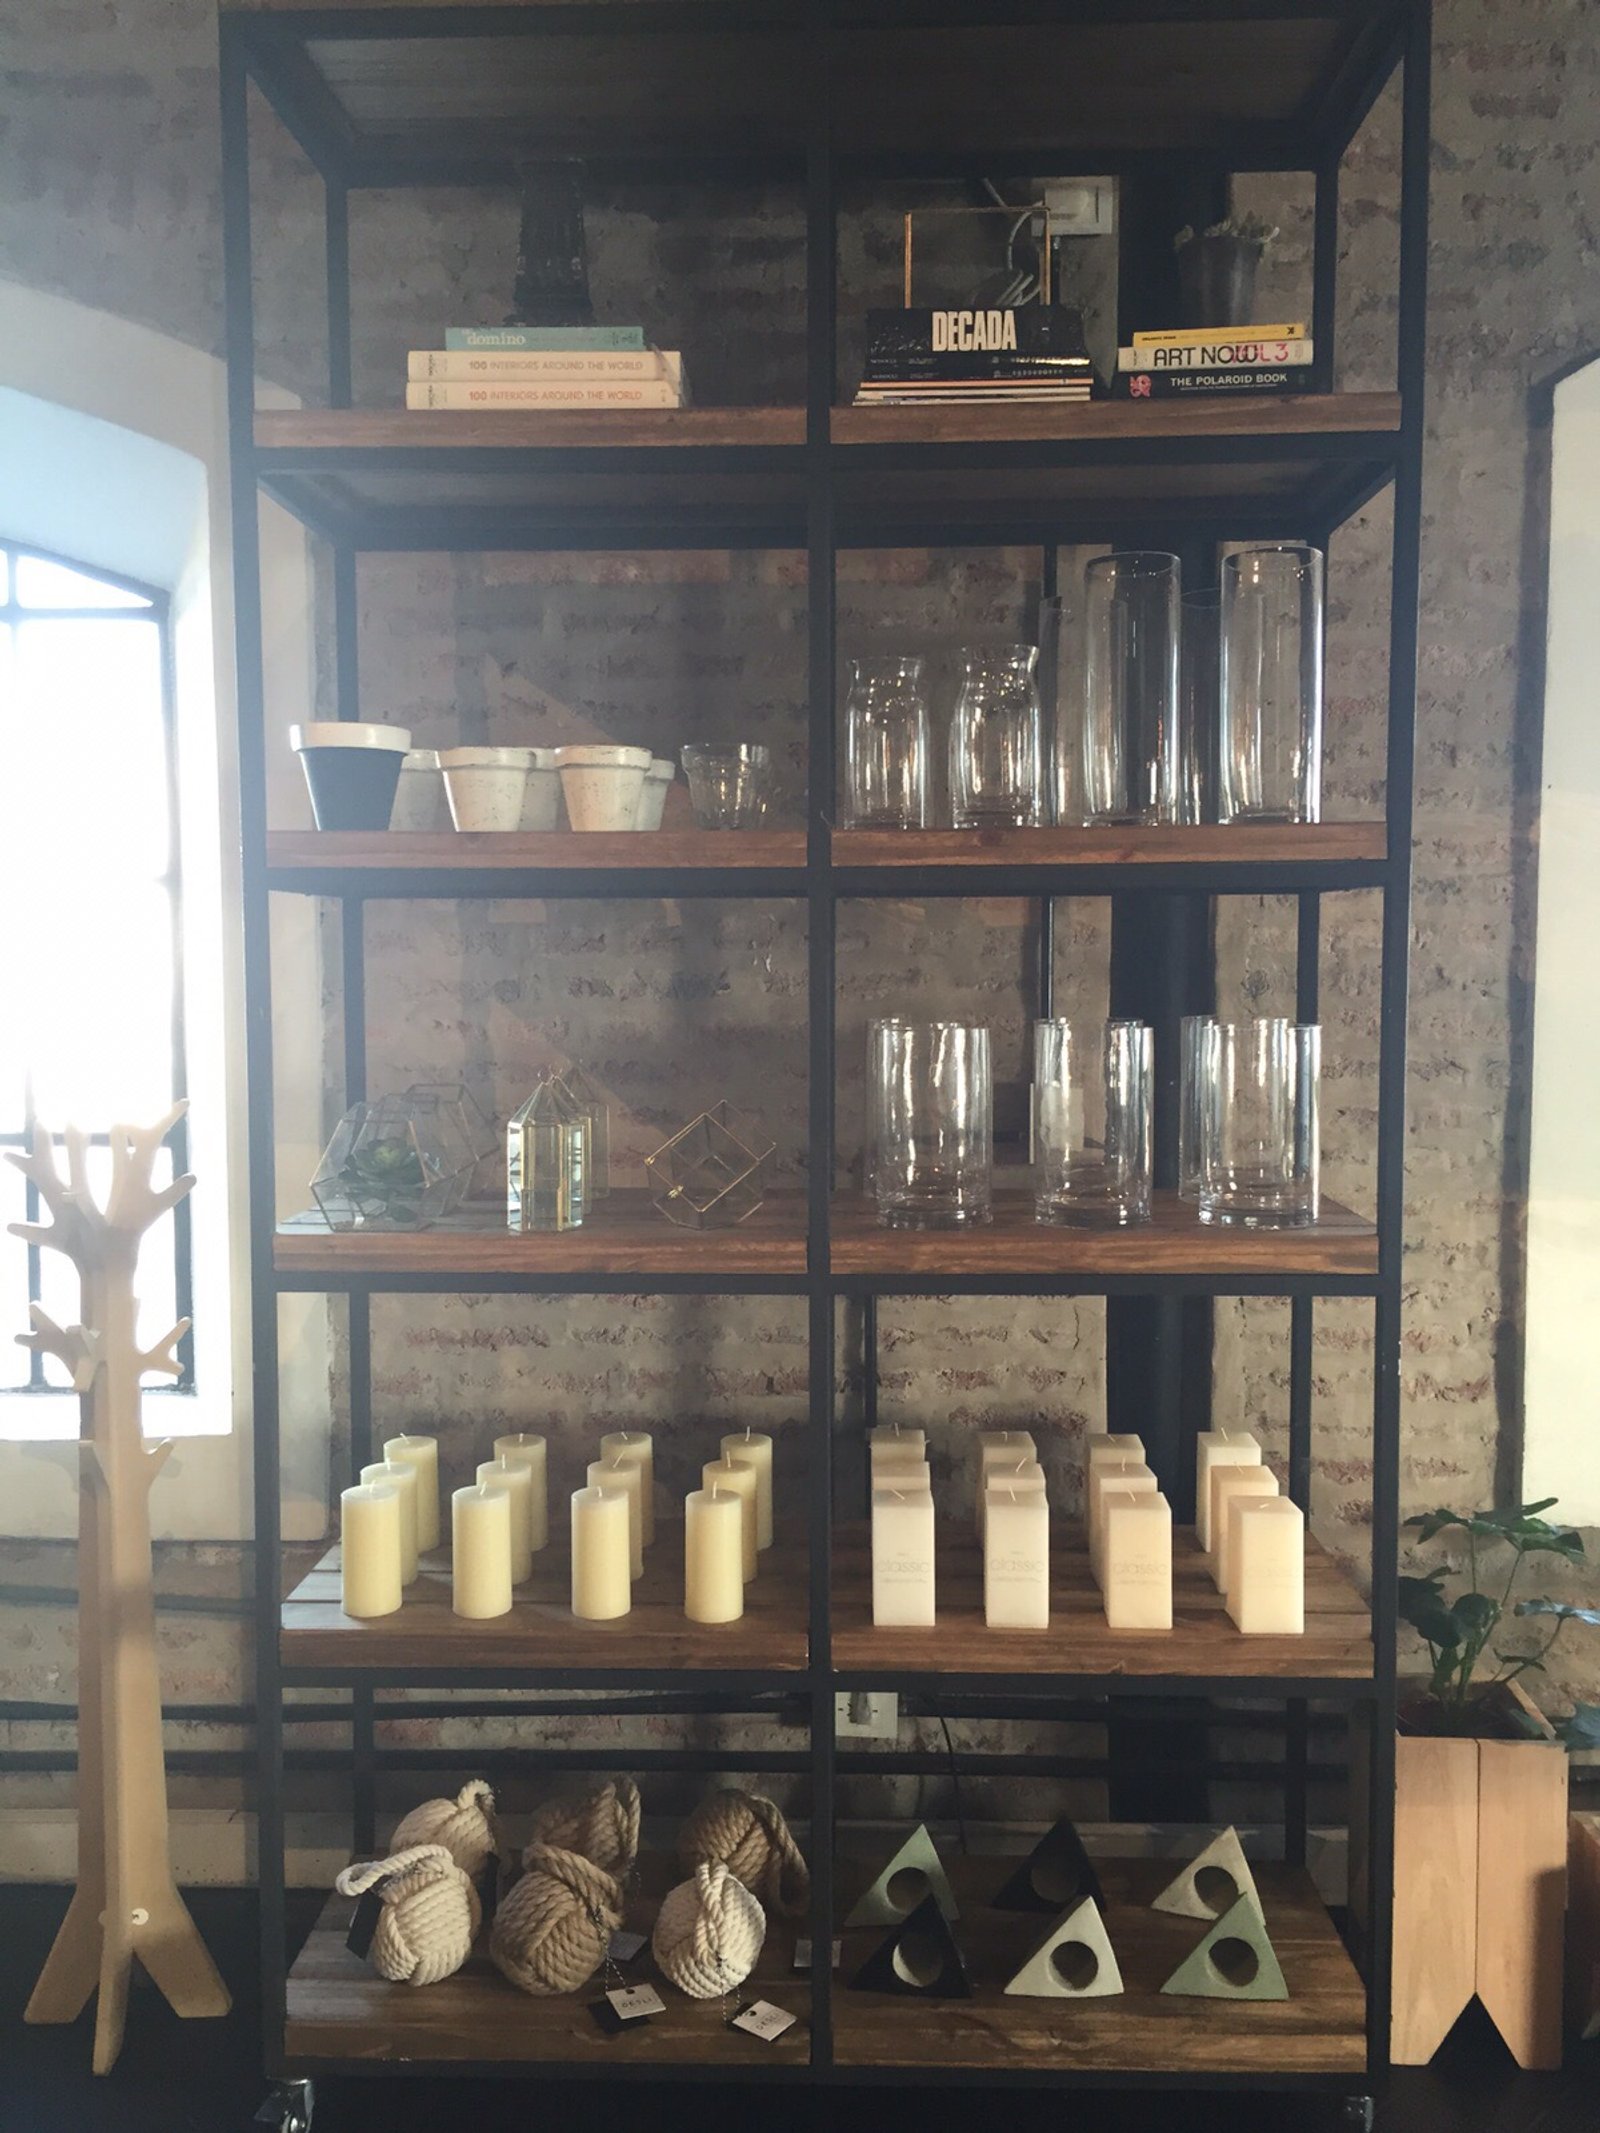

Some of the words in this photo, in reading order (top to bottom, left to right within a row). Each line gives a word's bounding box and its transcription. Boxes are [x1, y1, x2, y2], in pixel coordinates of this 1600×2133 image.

[931, 309, 1018, 352] DECADA
[466, 331, 527, 346] domino
[1153, 346, 1197, 367] ART
[1201, 344, 1259, 364] NOW
[1275, 342, 1289, 362] 3
[468, 360, 488, 370] 100
[489, 360, 540, 370] INTERIORS
[541, 360, 585, 370] AROUND
[587, 360, 604, 370] THE
[607, 360, 644, 370] WORLD
[1170, 376, 1193, 388] THE
[1195, 374, 1254, 386] POLAROID
[1255, 372, 1288, 384] BOOK
[468, 390, 488, 401] 100
[489, 390, 539, 401] INTERIORS
[540, 390, 585, 401] AROUND
[587, 390, 604, 401] THE
[607, 390, 643, 401] WORLD
